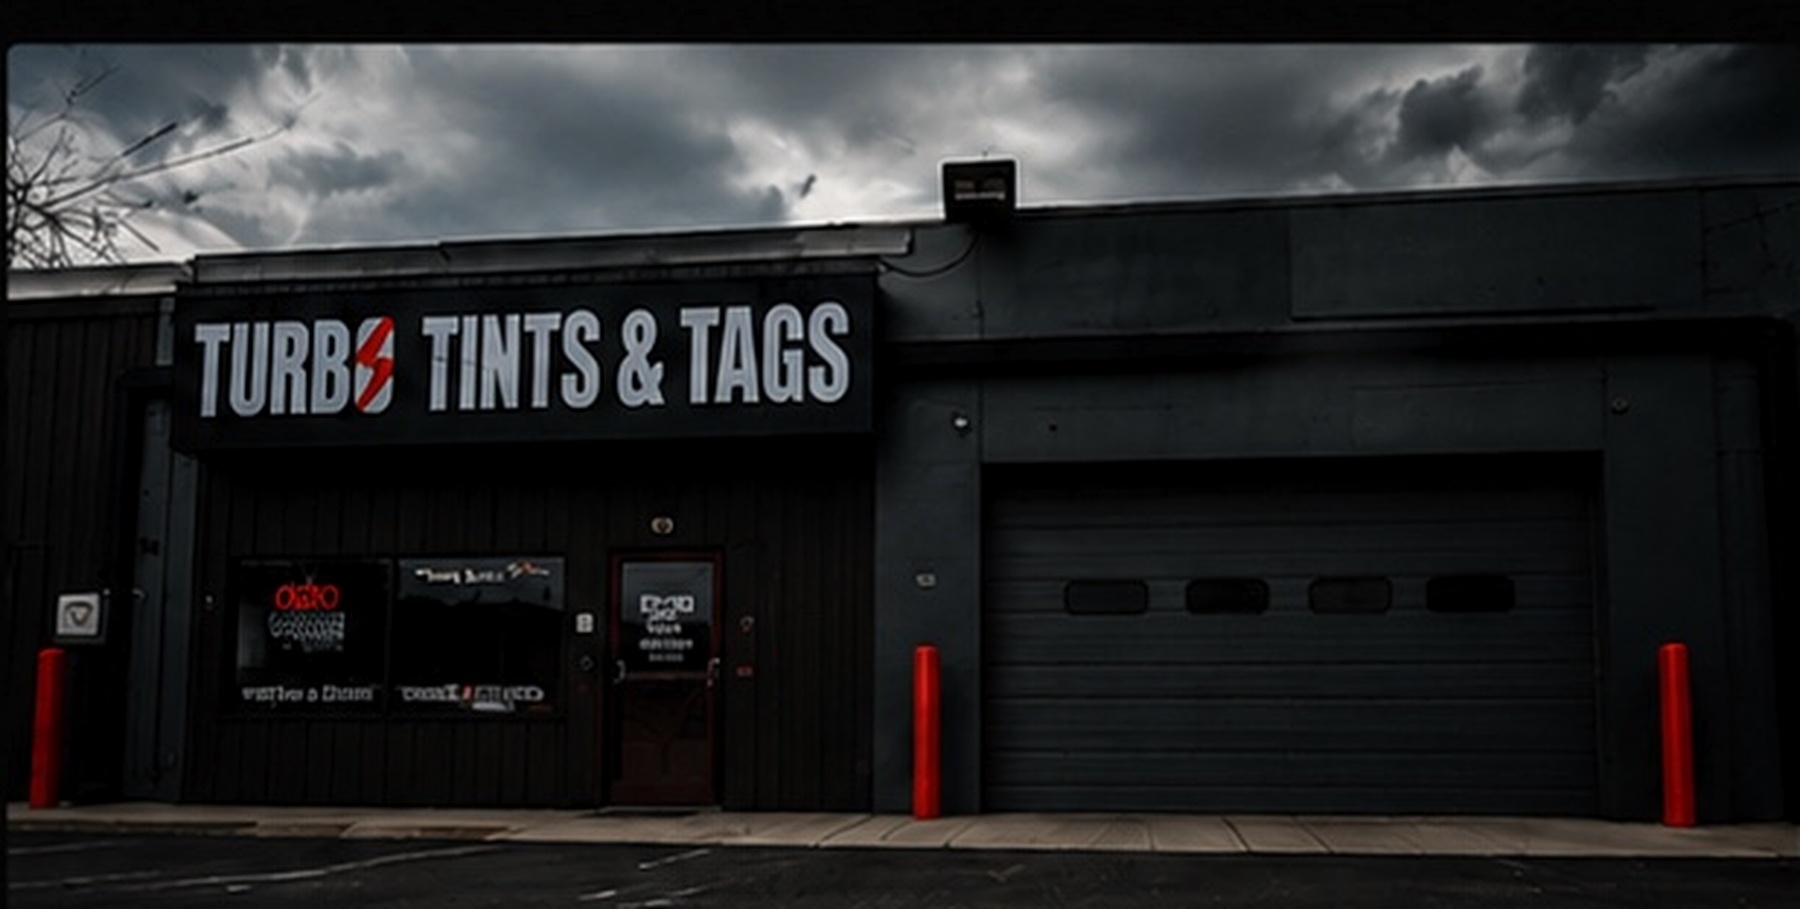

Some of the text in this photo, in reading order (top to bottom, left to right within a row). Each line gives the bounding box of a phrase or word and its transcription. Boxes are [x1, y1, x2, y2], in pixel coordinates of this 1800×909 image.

[195, 302, 850, 417] TURBO TINTS & TAGS
